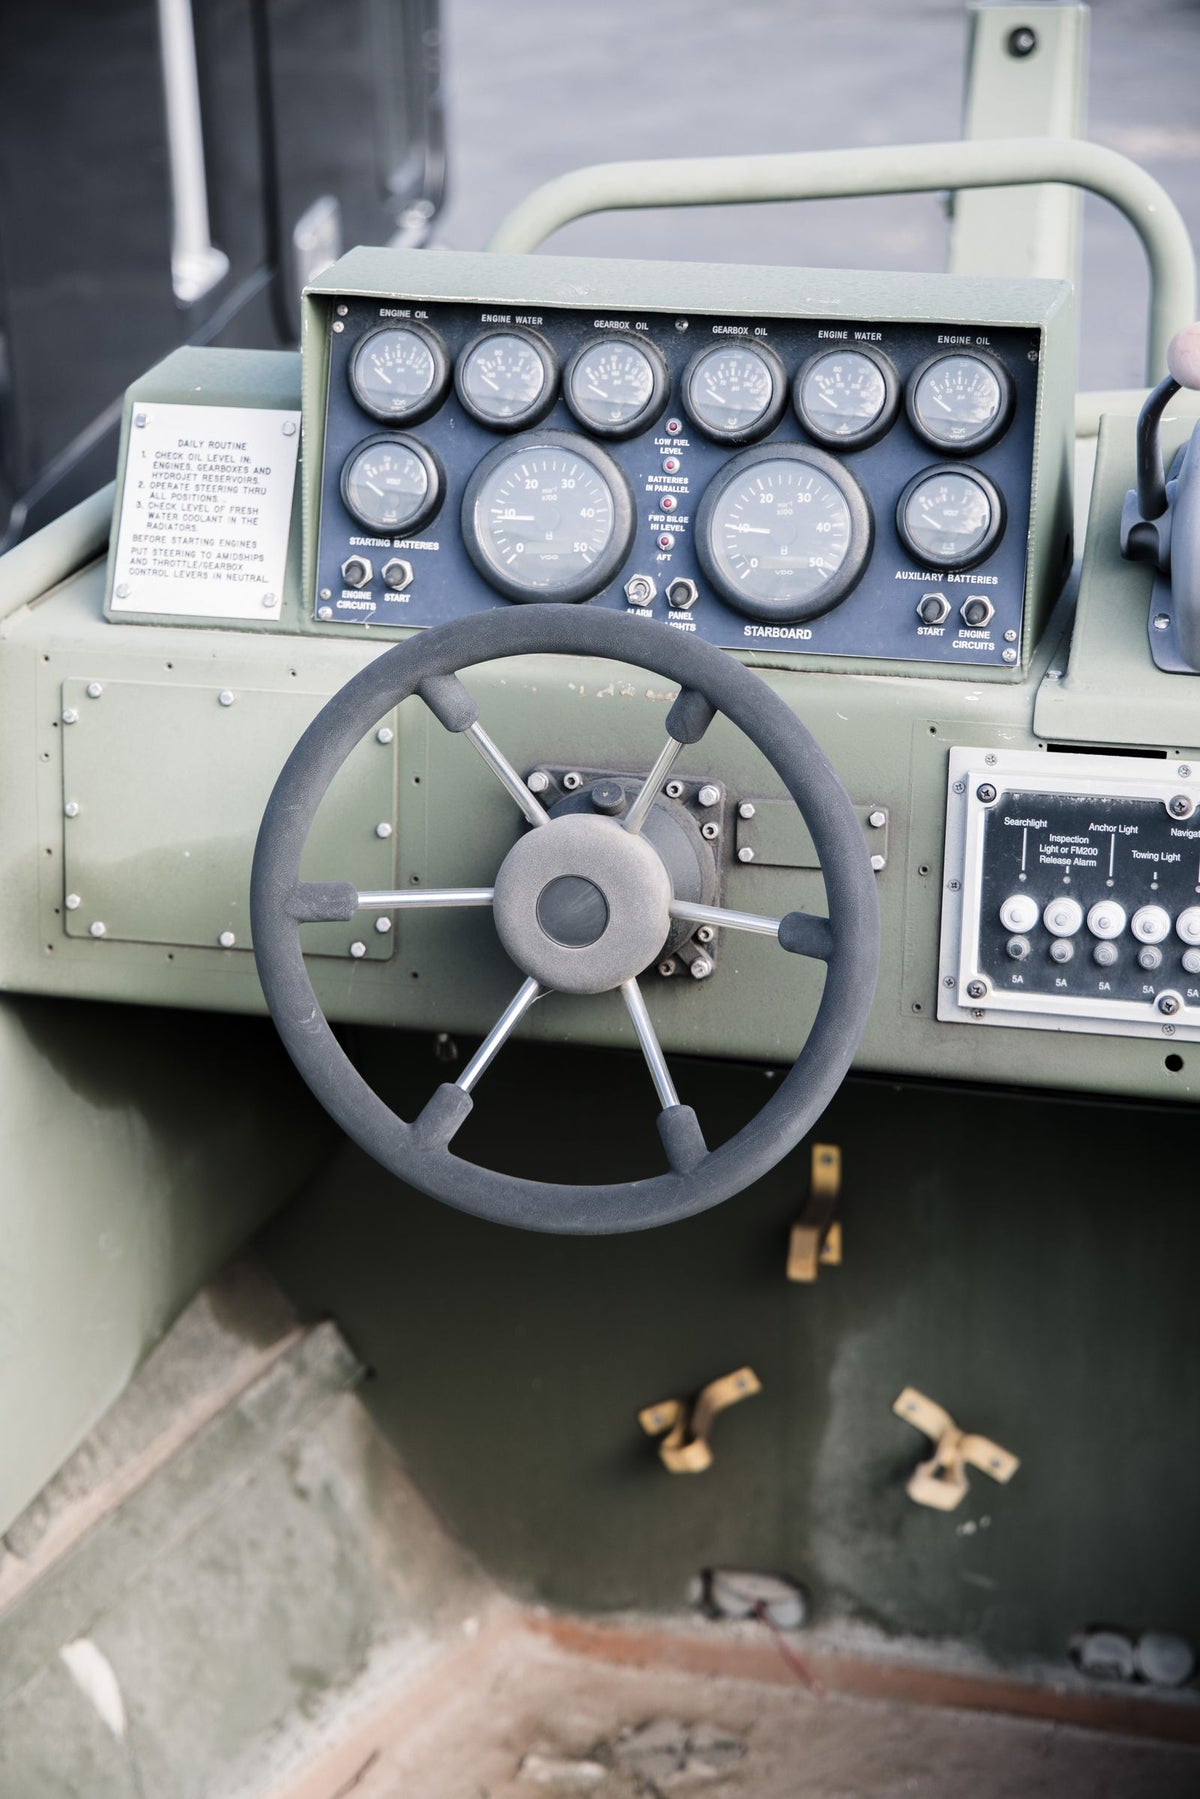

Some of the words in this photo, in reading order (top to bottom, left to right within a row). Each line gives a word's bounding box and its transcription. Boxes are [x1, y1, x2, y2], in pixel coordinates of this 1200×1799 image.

[379, 309, 411, 318] ENGINE
[415, 310, 428, 319] OIL
[481, 314, 511, 323] ENGINE
[515, 316, 543, 325] WATER
[594, 320, 630, 329] GEARBOX
[636, 322, 649, 330] OIL
[712, 326, 748, 335] GEARBOX
[755, 327, 768, 336] OIL
[818, 330, 848, 339] ENGINE
[854, 331, 882, 340] WATER
[937, 335, 970, 344] ENGINE
[976, 337, 990, 345] OIL
[178, 440, 204, 448] DAILY
[209, 441, 247, 451] ROUTINE
[655, 438, 671, 446] LOW
[660, 447, 683, 455] LEVEL
[155, 451, 183, 460] CHECK
[188, 453, 203, 461] OIL
[207, 454, 235, 463] LEVEL
[197, 464, 249, 474] GEARBOXES
[253, 467, 271, 475] AND
[152, 472, 197, 481] HYDROJET
[648, 476, 688, 485] BATTERIES
[138, 481, 145, 489] 2.
[150, 482, 190, 491] OPERATE
[195, 483, 239, 494] STEERING
[243, 486, 267, 495] THRU
[525, 479, 538, 489] 20
[561, 479, 575, 489] 30
[654, 485, 689, 493] PARALLEL
[150, 492, 167, 500] ALL
[760, 493, 773, 503] 20
[797, 493, 811, 503] 30
[148, 502, 176, 511] CHECK
[181, 503, 209, 512] LEVEL
[214, 505, 225, 513] OF
[230, 506, 259, 515] FRESH
[505, 508, 516, 517] 10
[580, 508, 594, 518] 40
[148, 512, 178, 521] WATER
[183, 514, 223, 524] COOLANT
[228, 516, 237, 524] IN
[242, 517, 259, 525] THE
[667, 515, 689, 523] BILGE
[816, 522, 830, 532] 40
[132, 534, 166, 544] BEFORE
[172, 536, 215, 547] STARTING
[219, 539, 257, 549] ENGINES
[349, 537, 390, 548] STARTING
[394, 540, 439, 550] BATTERIES
[516, 543, 524, 552] 0
[574, 542, 588, 552] 50
[131, 547, 148, 556] PUT
[153, 548, 196, 558] STEERING
[201, 551, 212, 559] TO
[216, 551, 264, 562] AMIDSHIPS
[130, 558, 148, 566] AND
[153, 559, 243, 571] THROTTLE/GEARBOX
[750, 558, 758, 568] 0
[809, 557, 823, 567] 50
[129, 568, 169, 577] CONTROL
[174, 570, 208, 579] LEVERS
[213, 572, 222, 580] IN
[895, 571, 943, 582] AUXILIARY
[947, 574, 998, 584] BATTERIES
[342, 591, 371, 600] ENGINE
[384, 593, 410, 602] START
[337, 601, 376, 610] CIRCUITS
[668, 612, 693, 621] PANEL
[665, 621, 696, 632] GHTS
[917, 627, 945, 636] START
[744, 625, 812, 640] STARBOARD
[959, 630, 990, 639] ENGINE
[953, 640, 995, 650] CIRCUITS
[1004, 817, 1048, 829] Searchlight
[1089, 823, 1117, 832] Anchor
[1119, 825, 1138, 835] Light
[1049, 834, 1089, 846] Inspection
[1039, 844, 1059, 854] Light
[1071, 846, 1098, 855] FM200
[1040, 855, 1071, 865] Release
[1073, 857, 1096, 866] Alarm
[1132, 850, 1159, 862] Towing
[1161, 852, 1181, 863] Light
[1012, 975, 1024, 984] 5A
[1055, 978, 1067, 987] 5A
[1099, 982, 1111, 991] 5A
[1142, 985, 1154, 994] 5A
[1187, 989, 1199, 998] 5A
